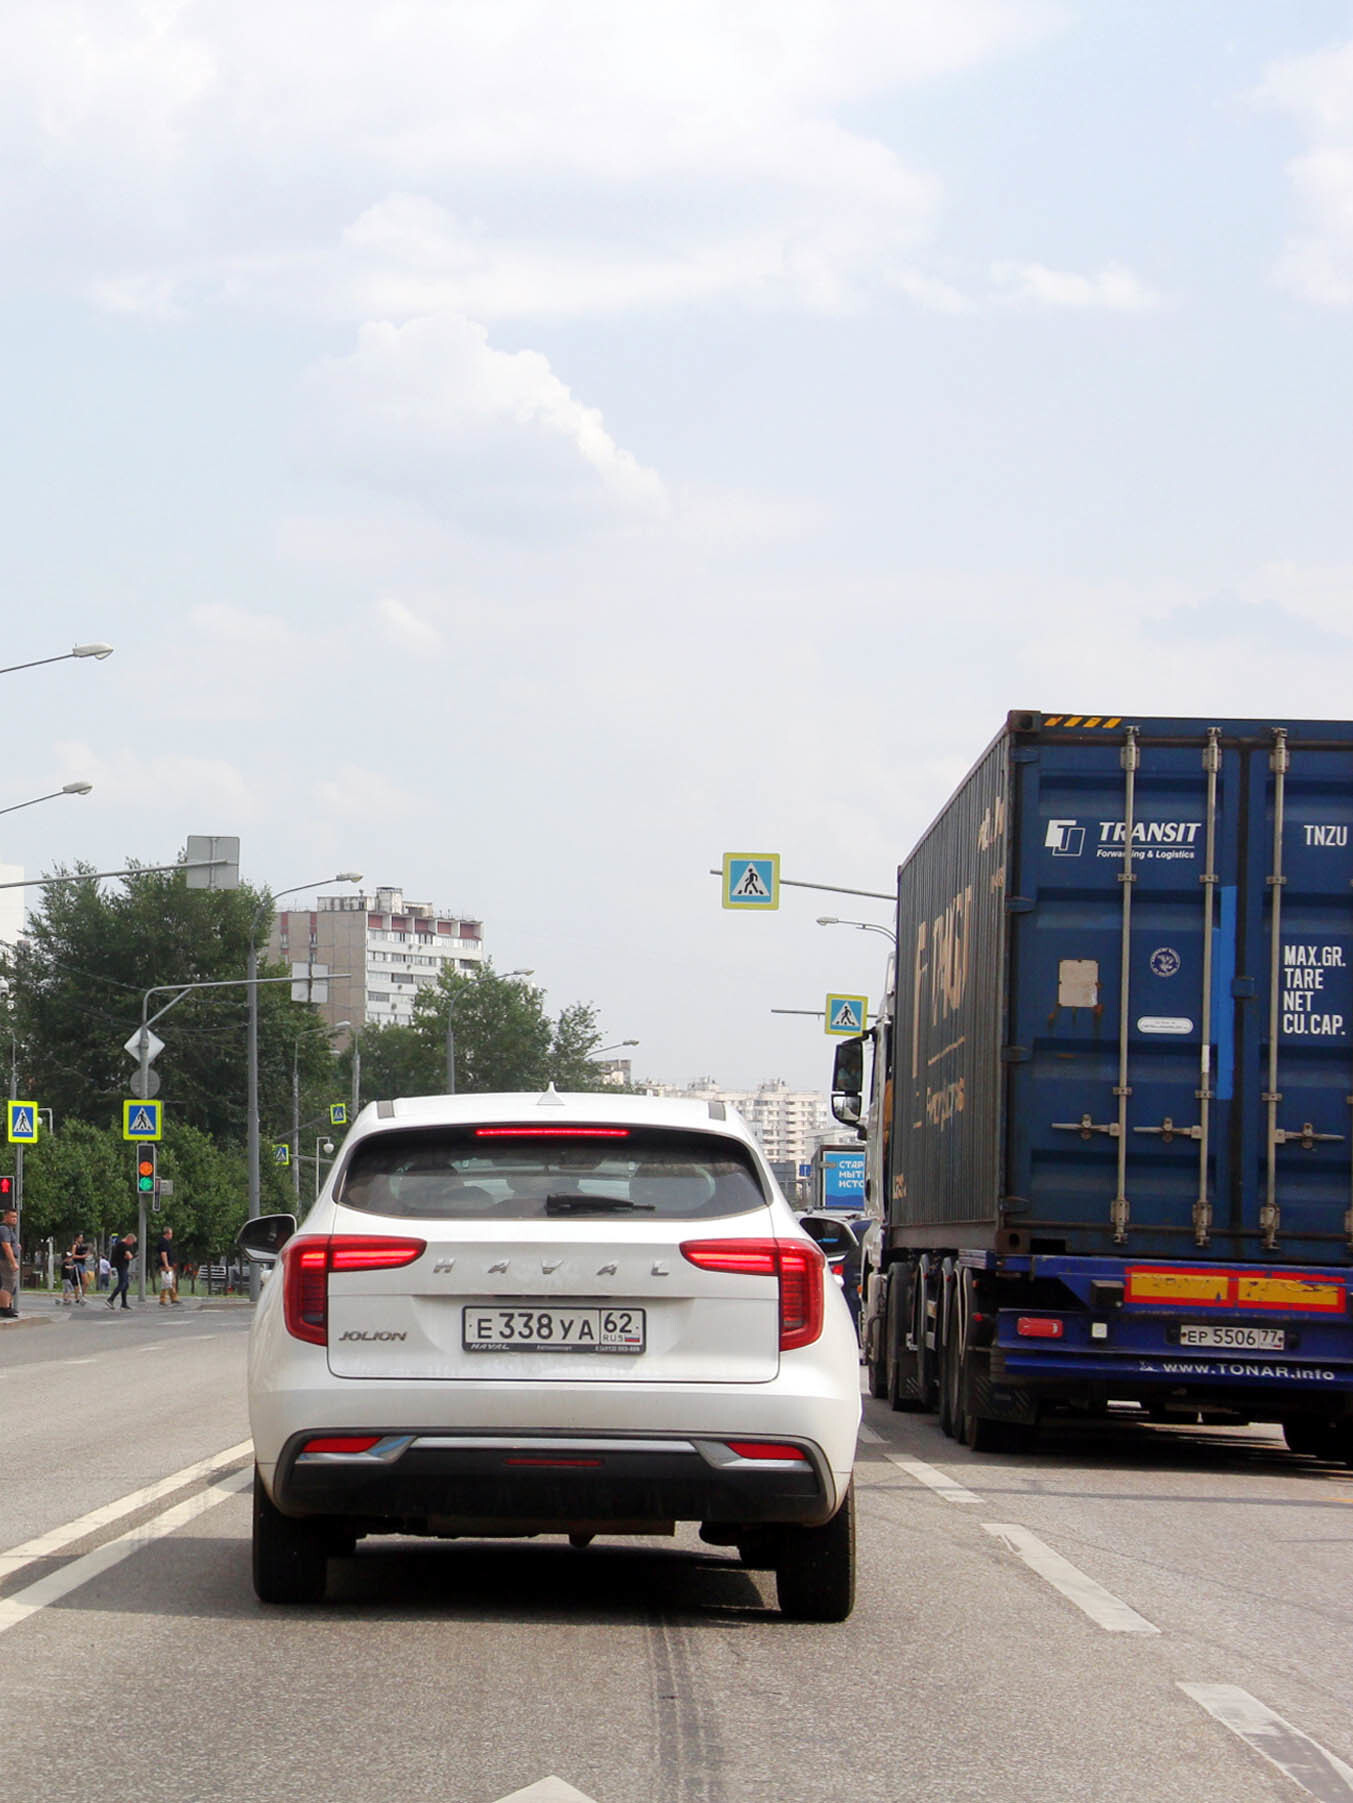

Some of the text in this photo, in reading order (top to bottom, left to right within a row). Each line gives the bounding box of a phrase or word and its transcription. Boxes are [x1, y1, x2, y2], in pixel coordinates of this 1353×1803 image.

[1099, 822, 1202, 842] TRANSIT
[1303, 824, 1348, 846] TNZU
[1146, 850, 1154, 858] &
[1155, 850, 1195, 860] Logistics
[1284, 945, 1346, 966] MAX.GR.
[1284, 968, 1324, 989] TARE
[1283, 991, 1314, 1011] NET
[432, 1257, 669, 1277] HAVAL
[604, 1312, 632, 1334] 62
[338, 1331, 408, 1341] JOLION
[603, 1334, 624, 1343] RUS
[1213, 1328, 1256, 1346] 5506
[1261, 1330, 1278, 1343] 77
[1163, 1363, 1335, 1381] www.TONAR.info
